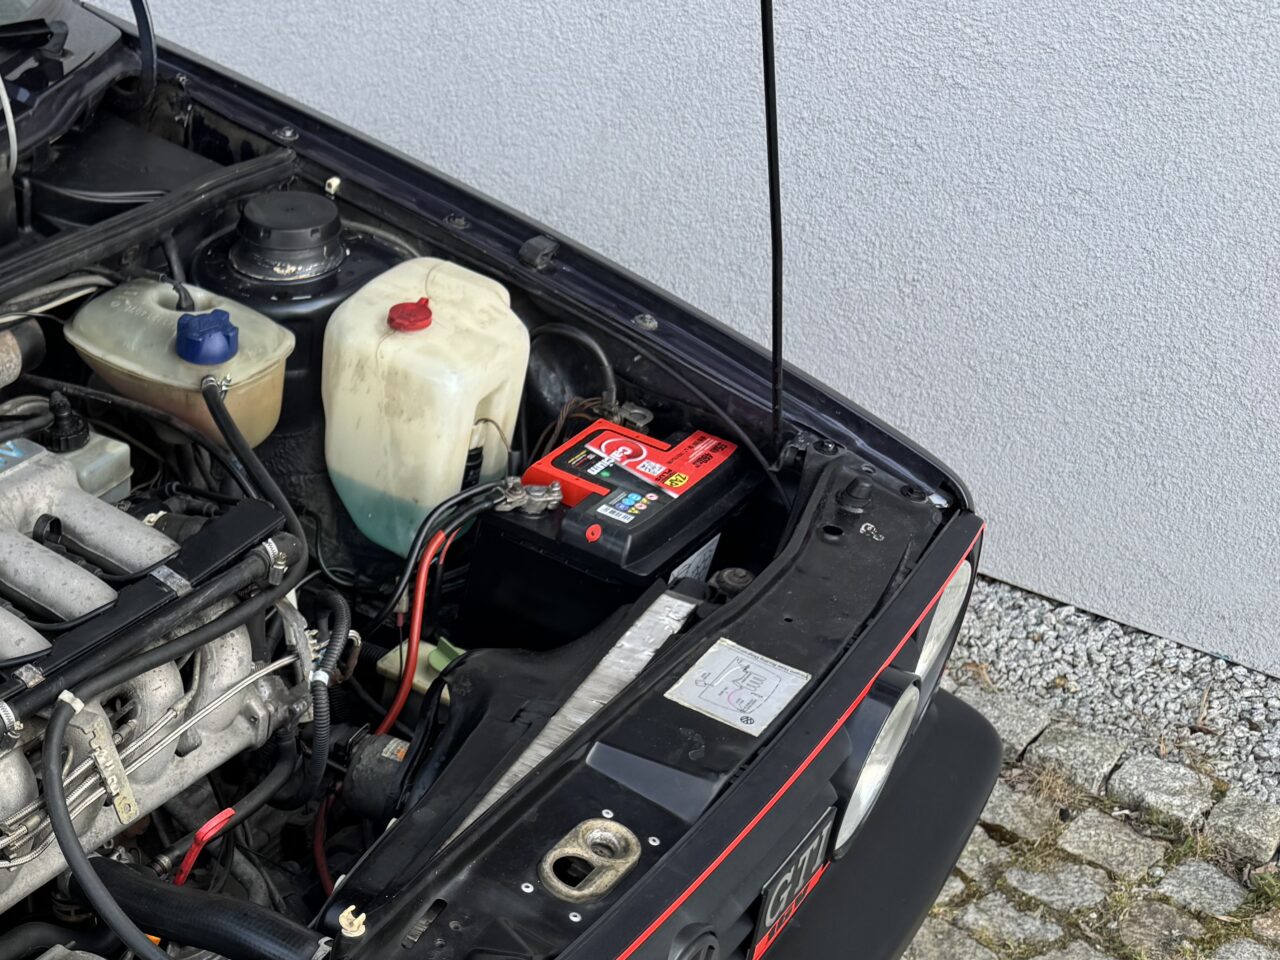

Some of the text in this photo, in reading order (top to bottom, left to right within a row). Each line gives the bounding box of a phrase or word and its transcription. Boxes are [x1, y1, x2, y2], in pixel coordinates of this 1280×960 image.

[586, 446, 632, 476] Calcium
[655, 469, 673, 483] PLUS
[669, 473, 687, 487] ZAP
[765, 820, 832, 928] GTI
